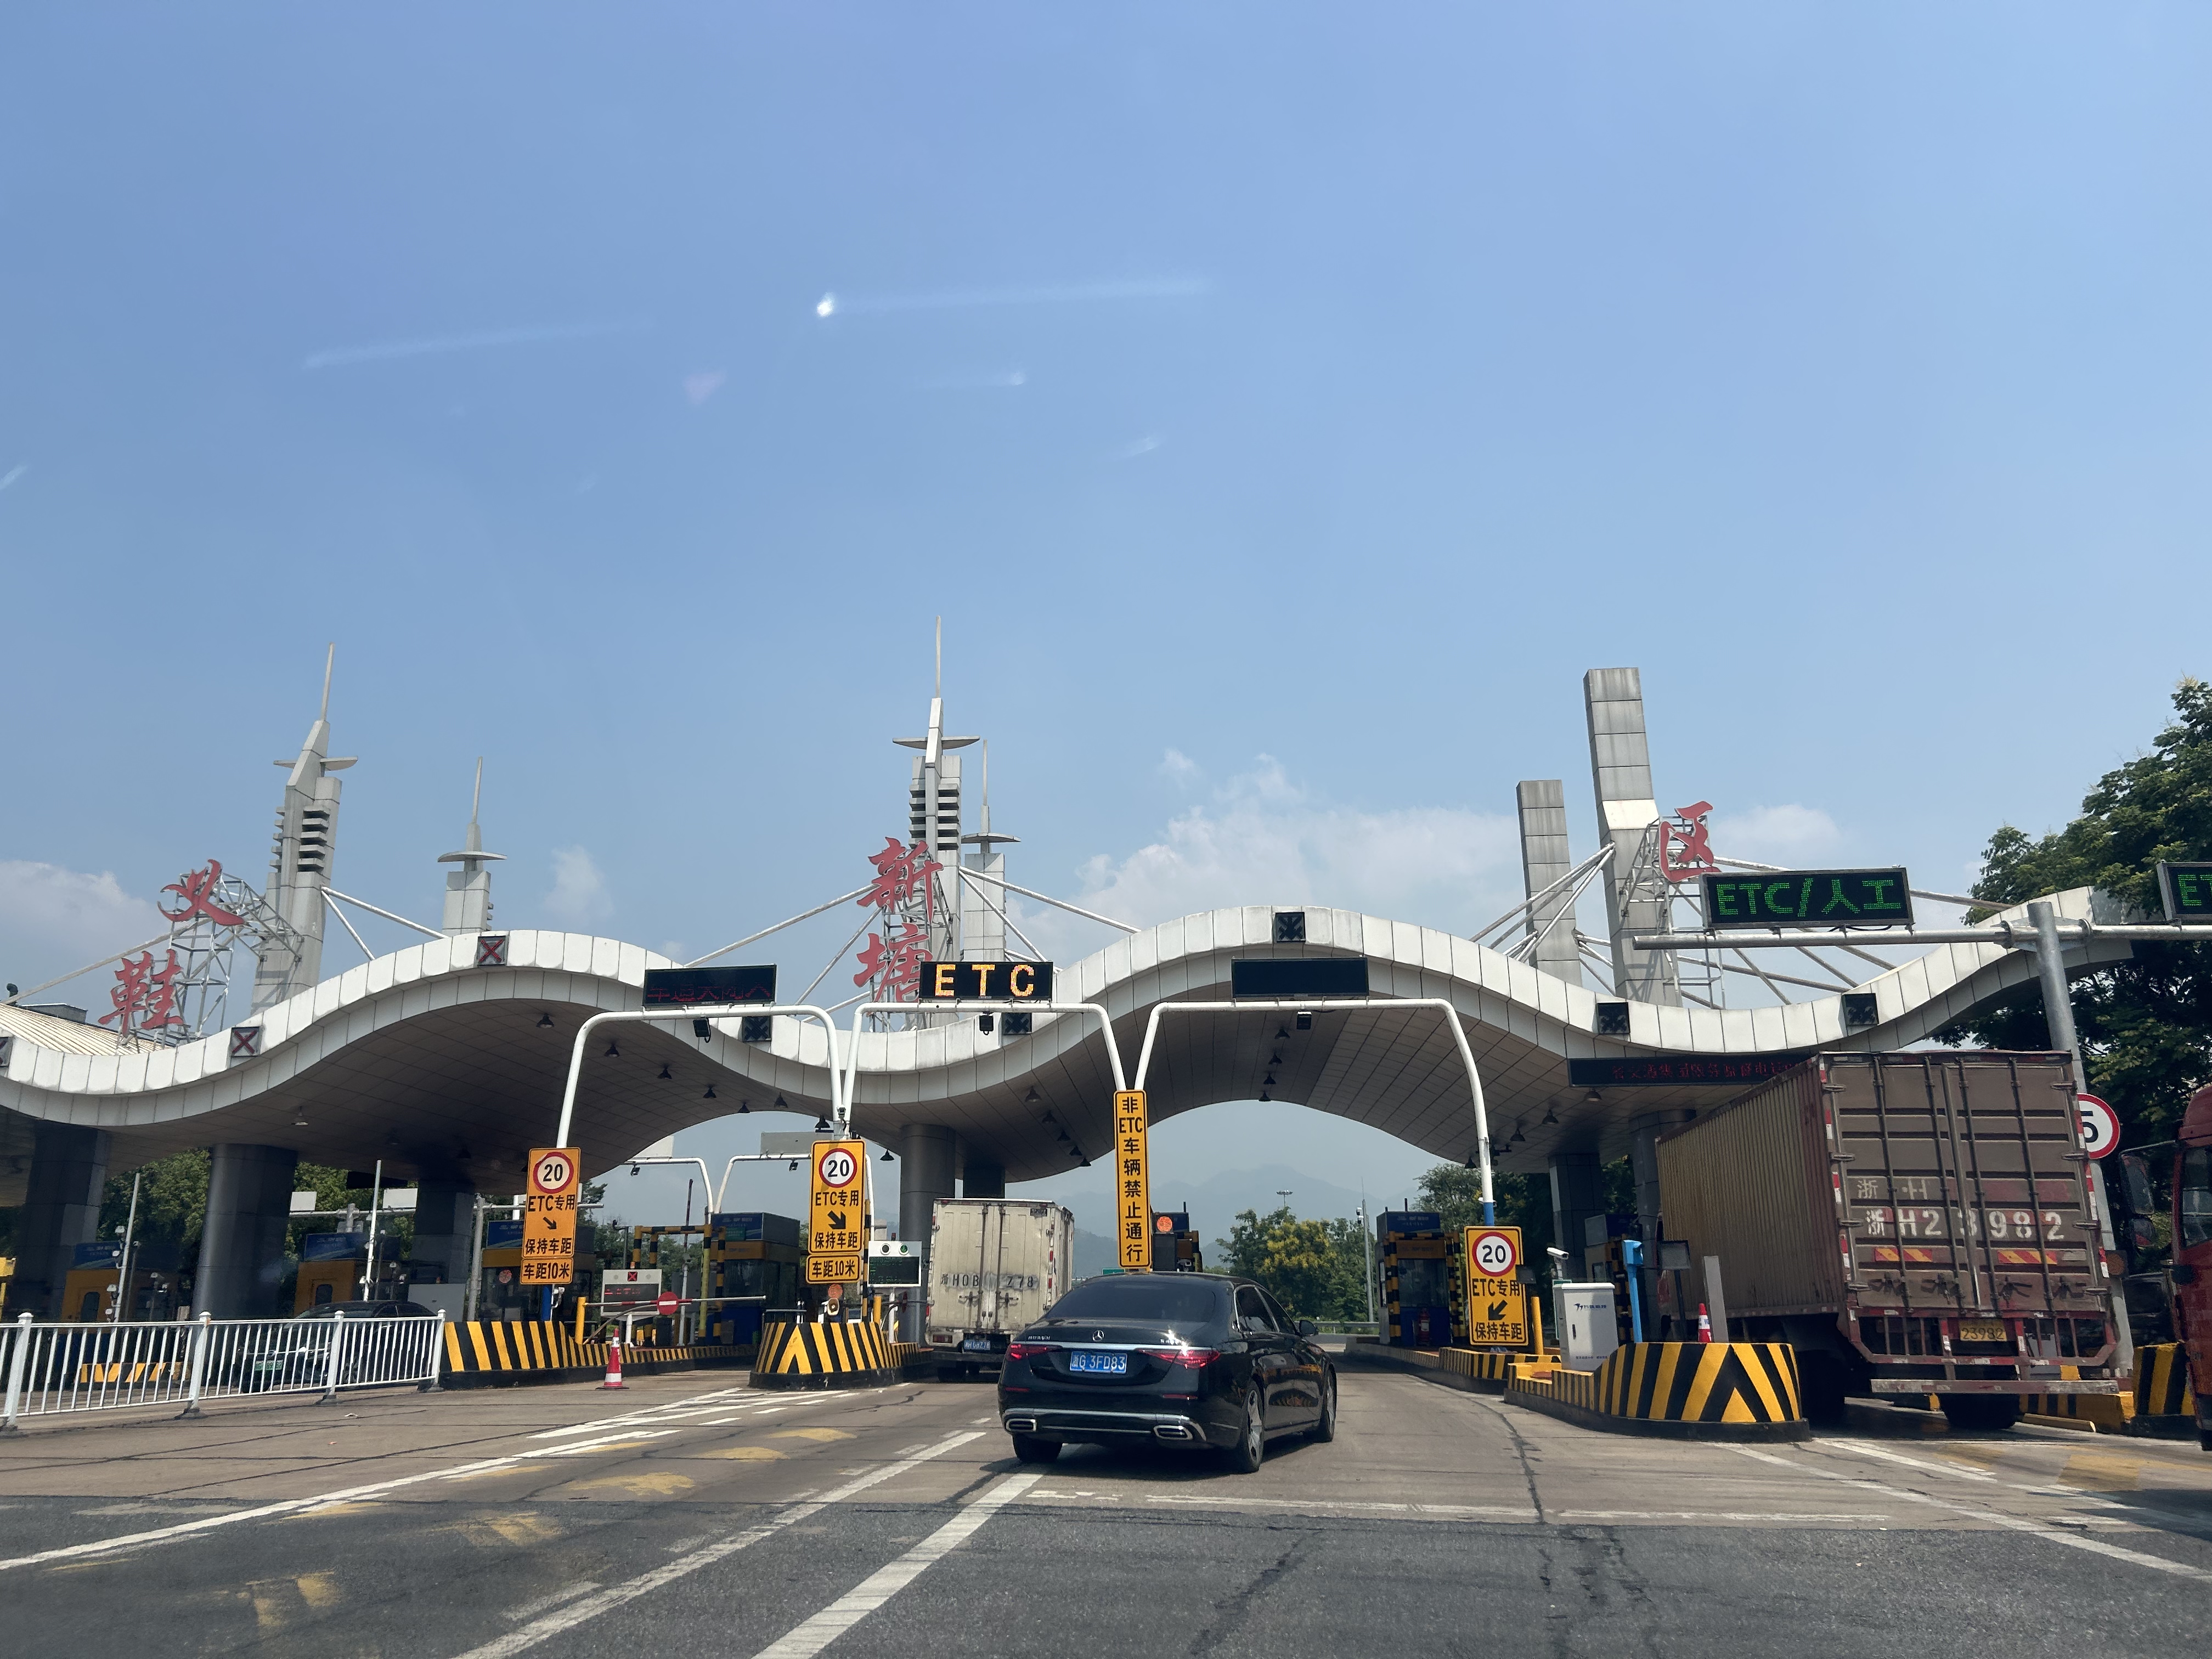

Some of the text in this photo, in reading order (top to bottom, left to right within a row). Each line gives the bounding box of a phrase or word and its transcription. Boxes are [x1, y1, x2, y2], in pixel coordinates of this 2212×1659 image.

[1659, 801, 1722, 883] 区
[856, 837, 944, 926] 新
[1716, 878, 1901, 917] ETC/人工
[935, 964, 1035, 997] ETC
[2080, 1110, 2099, 1143] 5
[543, 1164, 563, 1182] 20
[827, 1159, 850, 1177] 20
[1119, 1096, 1143, 1262] 非ETC车辆禁止通行
[527, 1194, 575, 1212] ETC专用
[815, 1189, 860, 1207] ETC专用
[525, 1238, 572, 1255] 保持车距
[814, 1232, 858, 1249] 保持车距
[1482, 1244, 1506, 1263] 20
[523, 1262, 570, 1280] 车距10米
[811, 1260, 855, 1278] 车距10米
[1472, 1278, 1521, 1297] ETC专用
[1475, 1322, 1523, 1340] 保持车距
[1961, 1328, 2004, 1340] 23982
